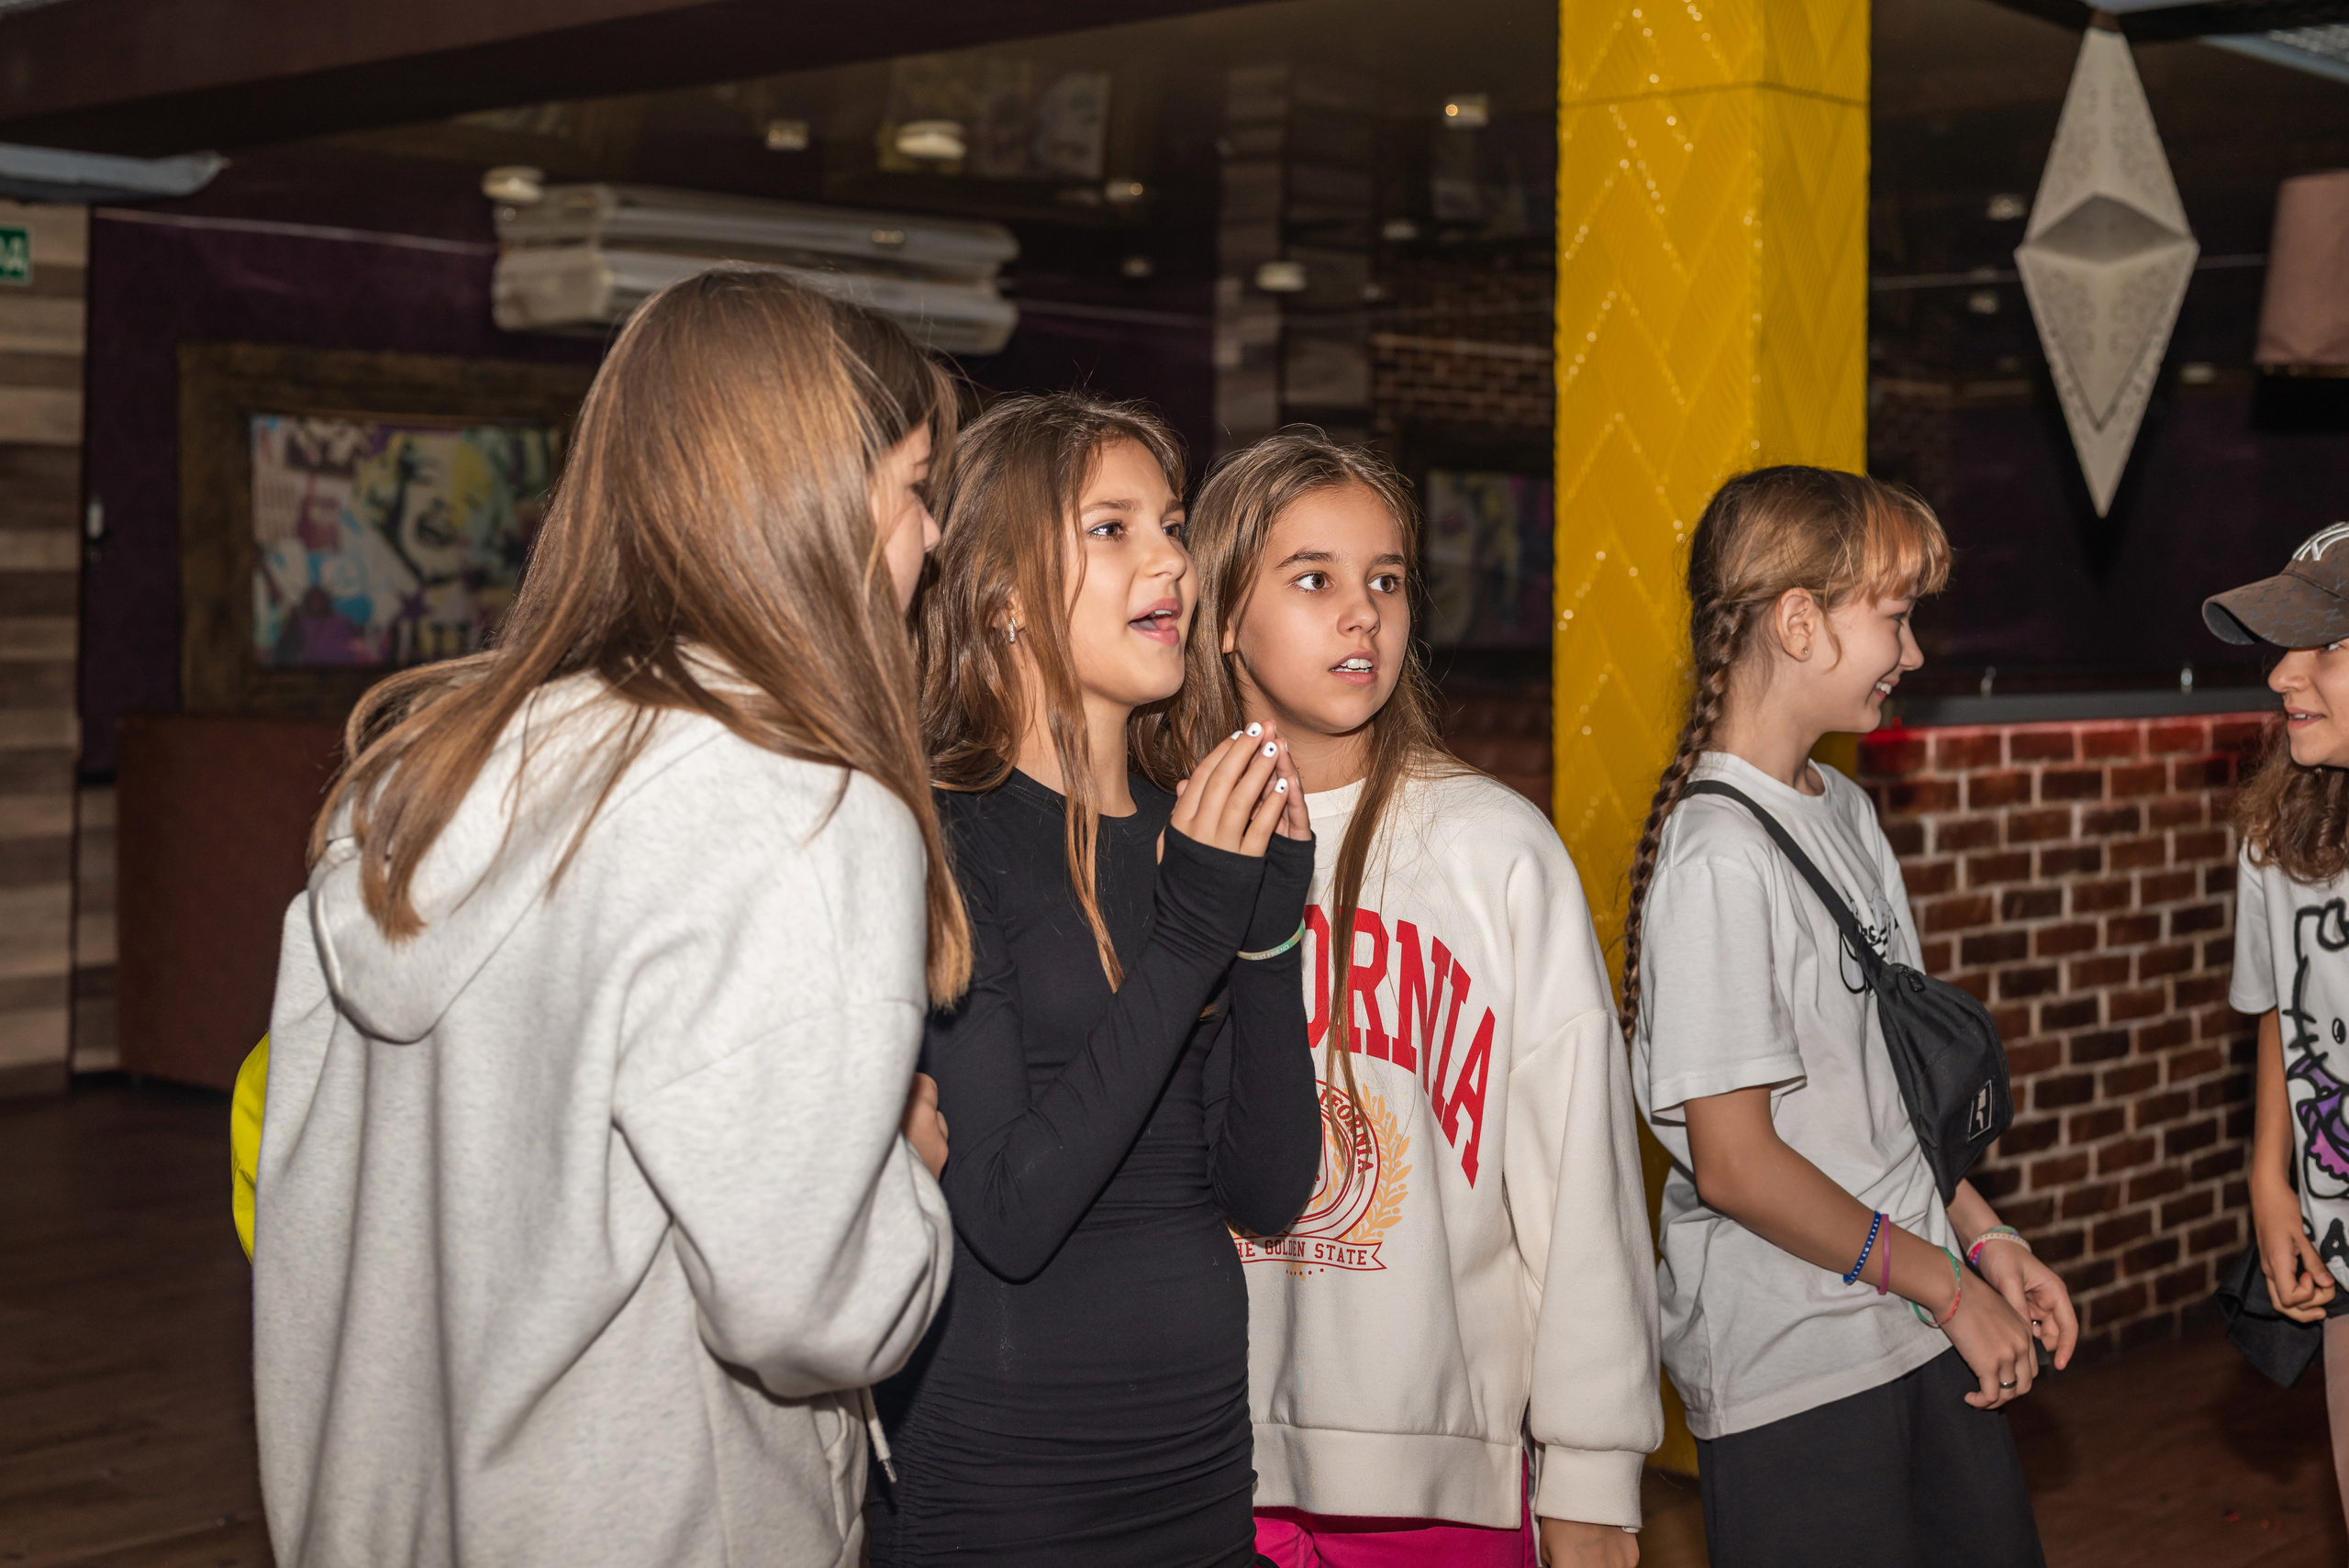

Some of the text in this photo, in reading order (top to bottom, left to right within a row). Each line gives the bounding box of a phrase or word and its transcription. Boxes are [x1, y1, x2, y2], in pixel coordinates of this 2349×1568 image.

[1267, 944, 1290, 958] FRIEND
[1264, 1239, 1306, 1258] GOLDEN
[1314, 1242, 1367, 1266] STATE
